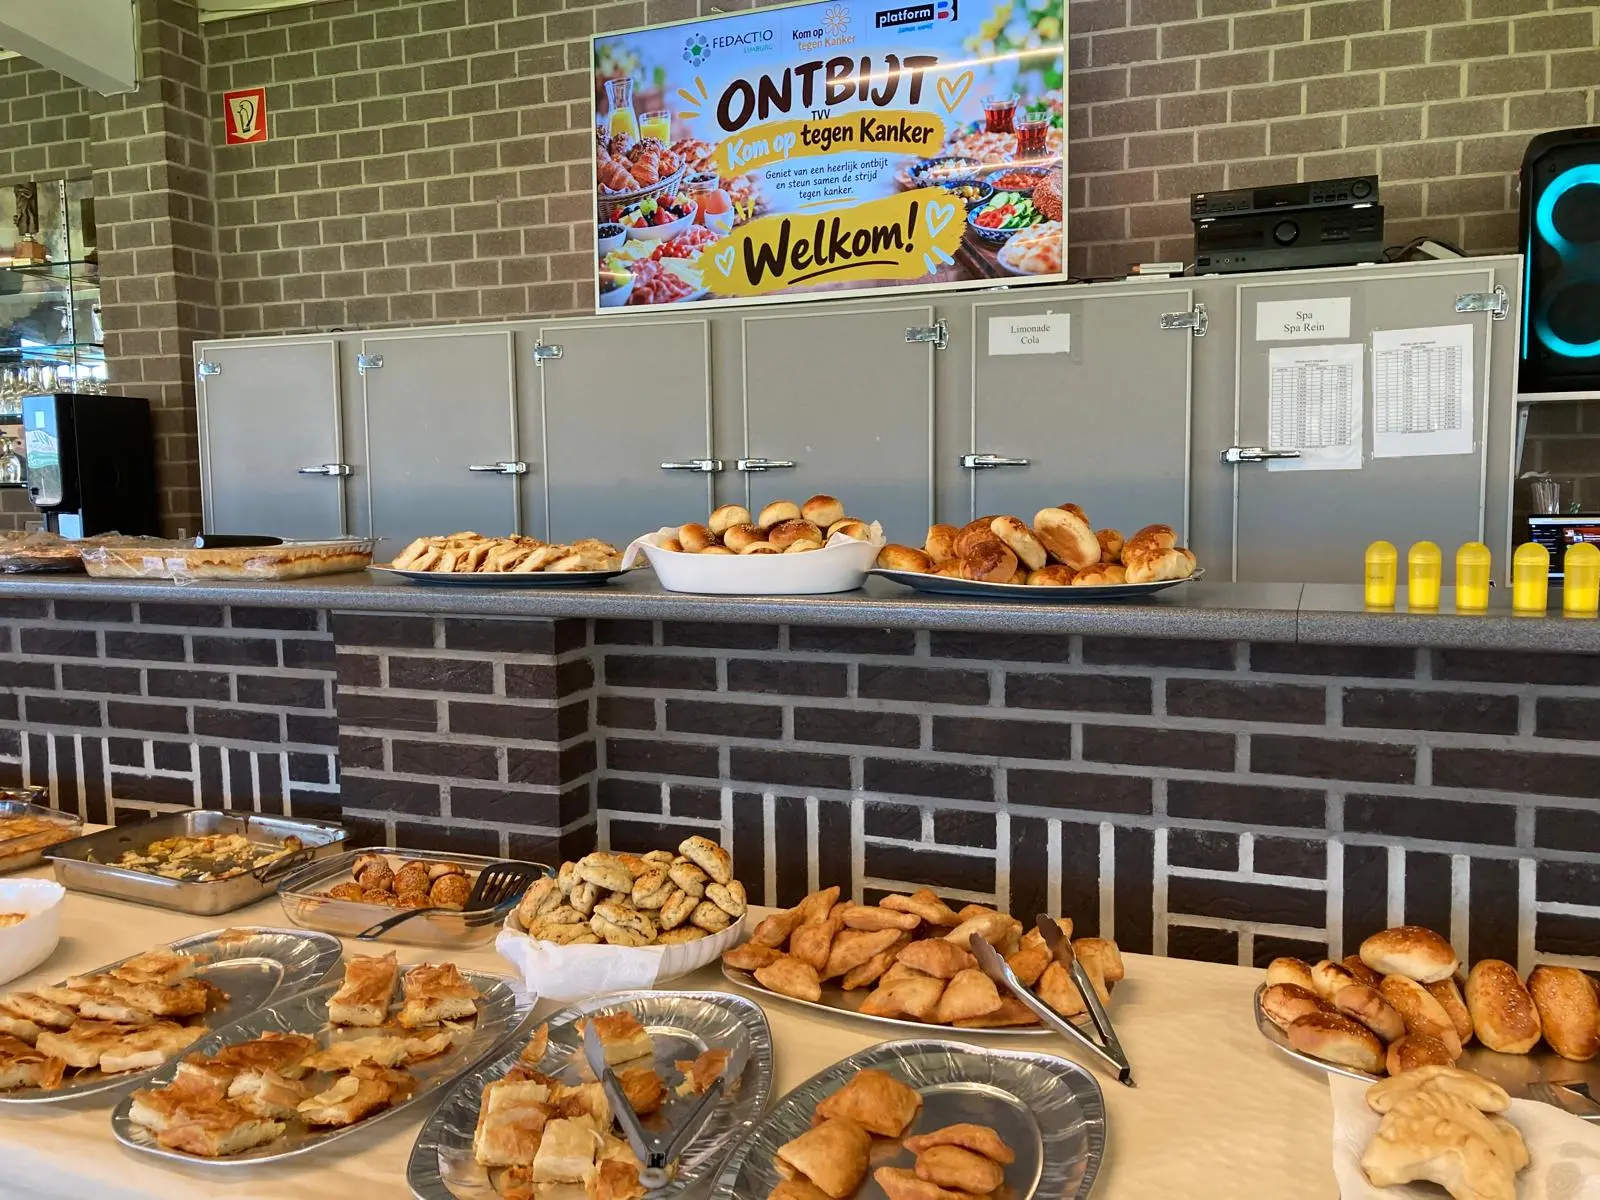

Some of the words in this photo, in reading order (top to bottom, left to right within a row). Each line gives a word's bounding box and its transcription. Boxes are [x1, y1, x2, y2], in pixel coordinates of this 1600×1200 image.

[879, 8, 932, 29] platform
[792, 29, 811, 40] Kom
[812, 28, 824, 40] op
[799, 38, 823, 51] tegen
[824, 34, 857, 48] Kanker
[716, 54, 939, 132] ONTBIJT
[811, 109, 830, 121] TVV
[726, 136, 770, 170] Kom
[773, 130, 796, 159] op
[800, 123, 854, 151] tegen
[859, 117, 934, 144] Kanker
[765, 170, 792, 180] Geniet
[793, 168, 808, 177] van
[810, 166, 825, 175] een
[827, 161, 858, 173] heerlijk
[860, 157, 889, 169] ontbijt
[776, 181, 786, 190] en
[788, 179, 811, 188] steun
[813, 176, 840, 186] samen
[842, 173, 852, 183] de
[854, 170, 878, 182] strijd
[799, 188, 821, 200] tegen
[823, 186, 854, 197] kanker.
[743, 201, 919, 286] Welkom!
[1296, 310, 1313, 322] Spa
[1010, 323, 1051, 334] Limonade
[1283, 323, 1301, 334] Spa
[1302, 322, 1326, 332] Rein
[1020, 335, 1040, 345] Cola
